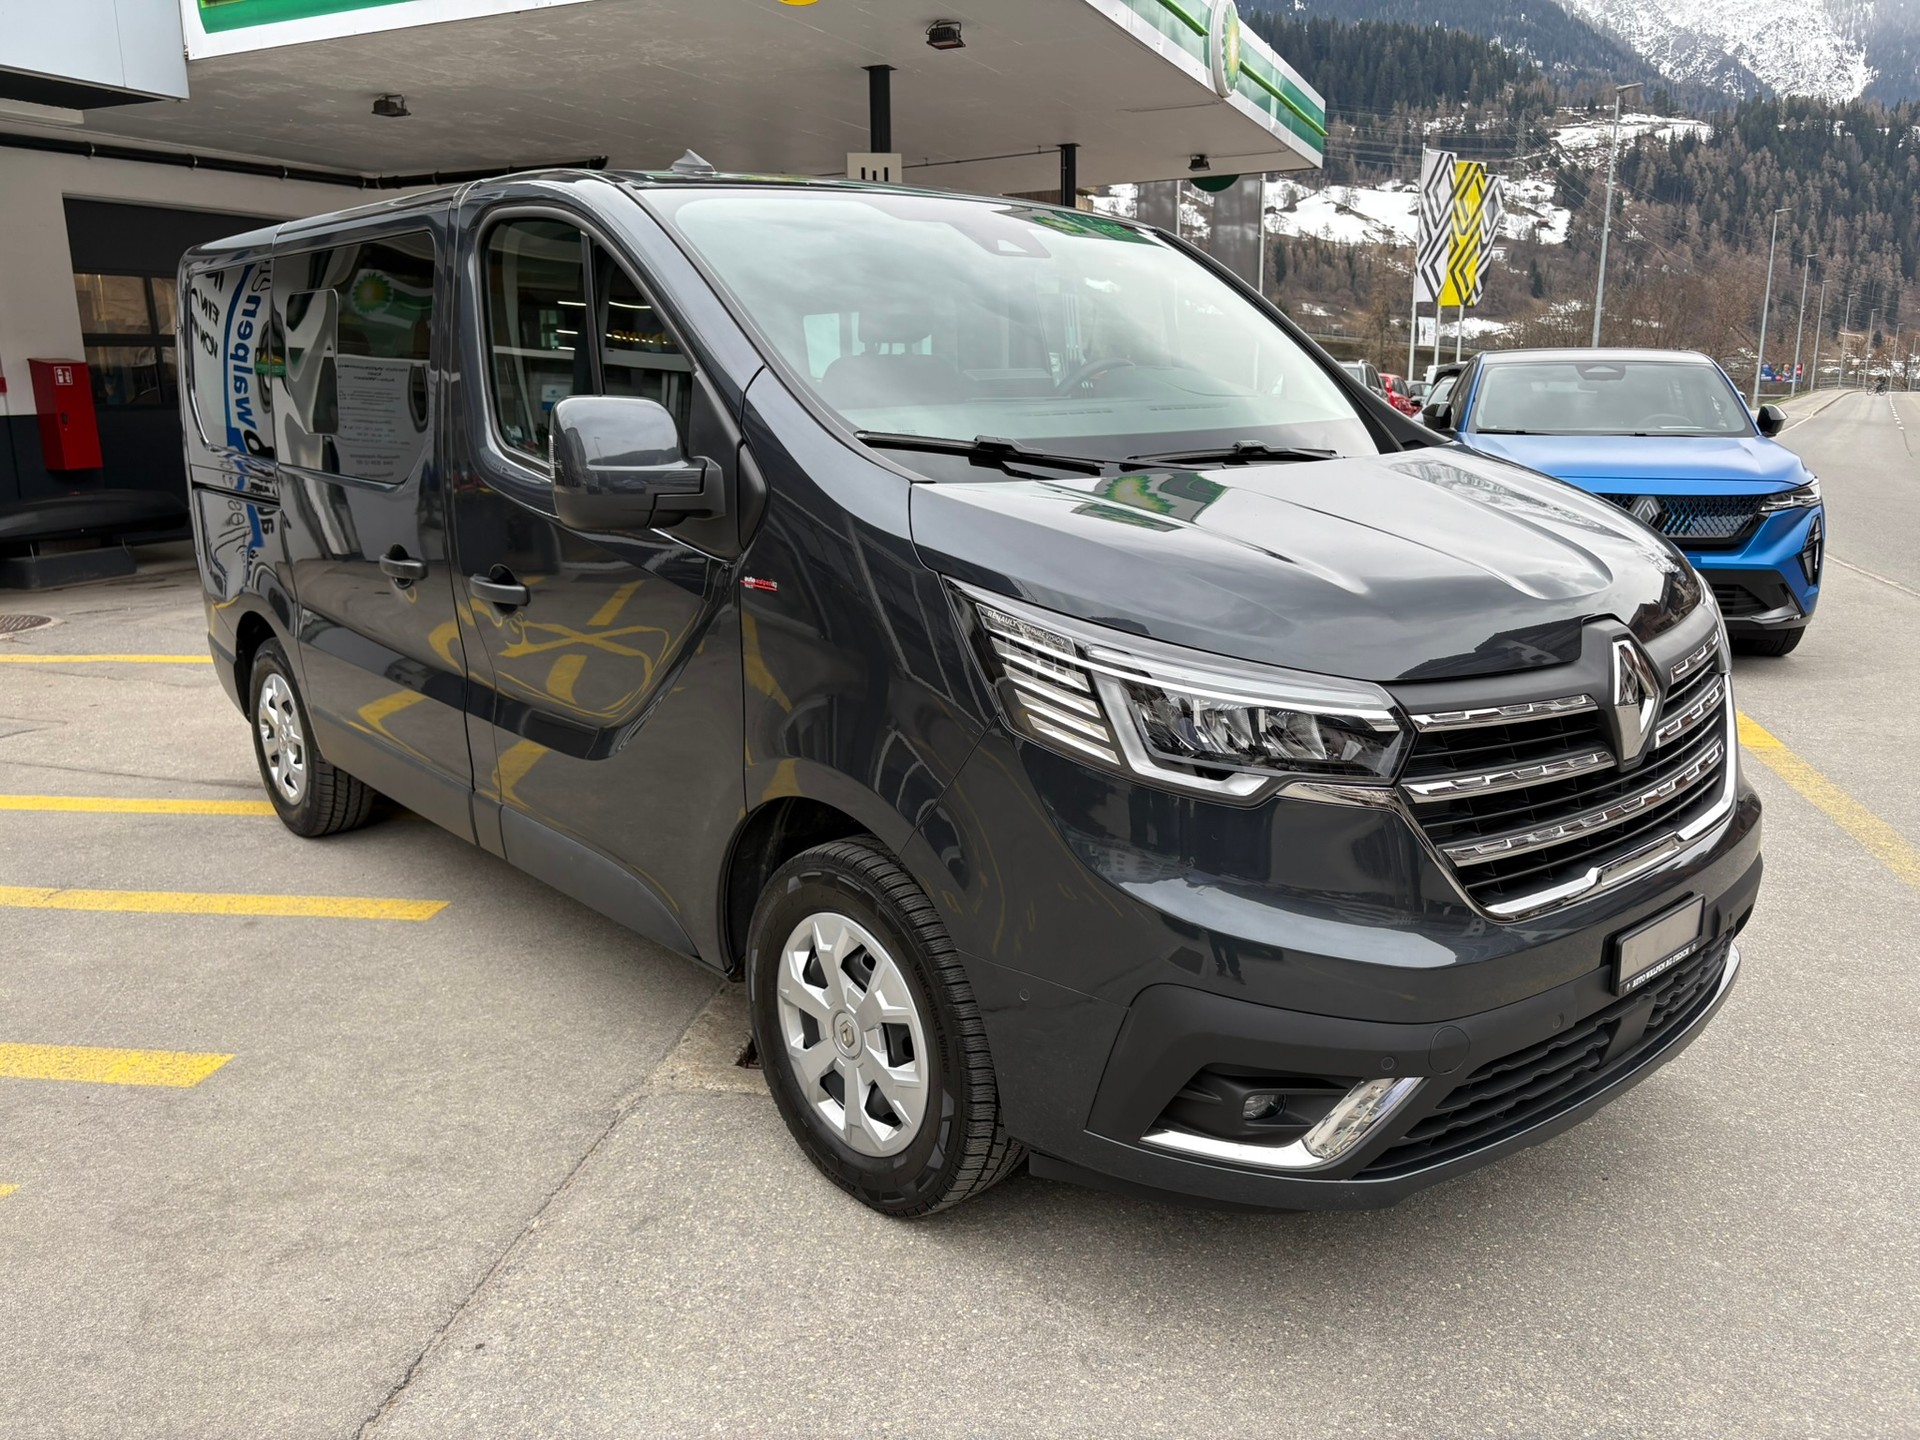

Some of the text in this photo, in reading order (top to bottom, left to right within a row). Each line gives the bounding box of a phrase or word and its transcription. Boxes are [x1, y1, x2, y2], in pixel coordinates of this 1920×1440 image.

[987, 610, 1017, 627] RENAULT
[1046, 632, 1065, 645] VISION
[914, 963, 950, 1074] VanContact Winter
